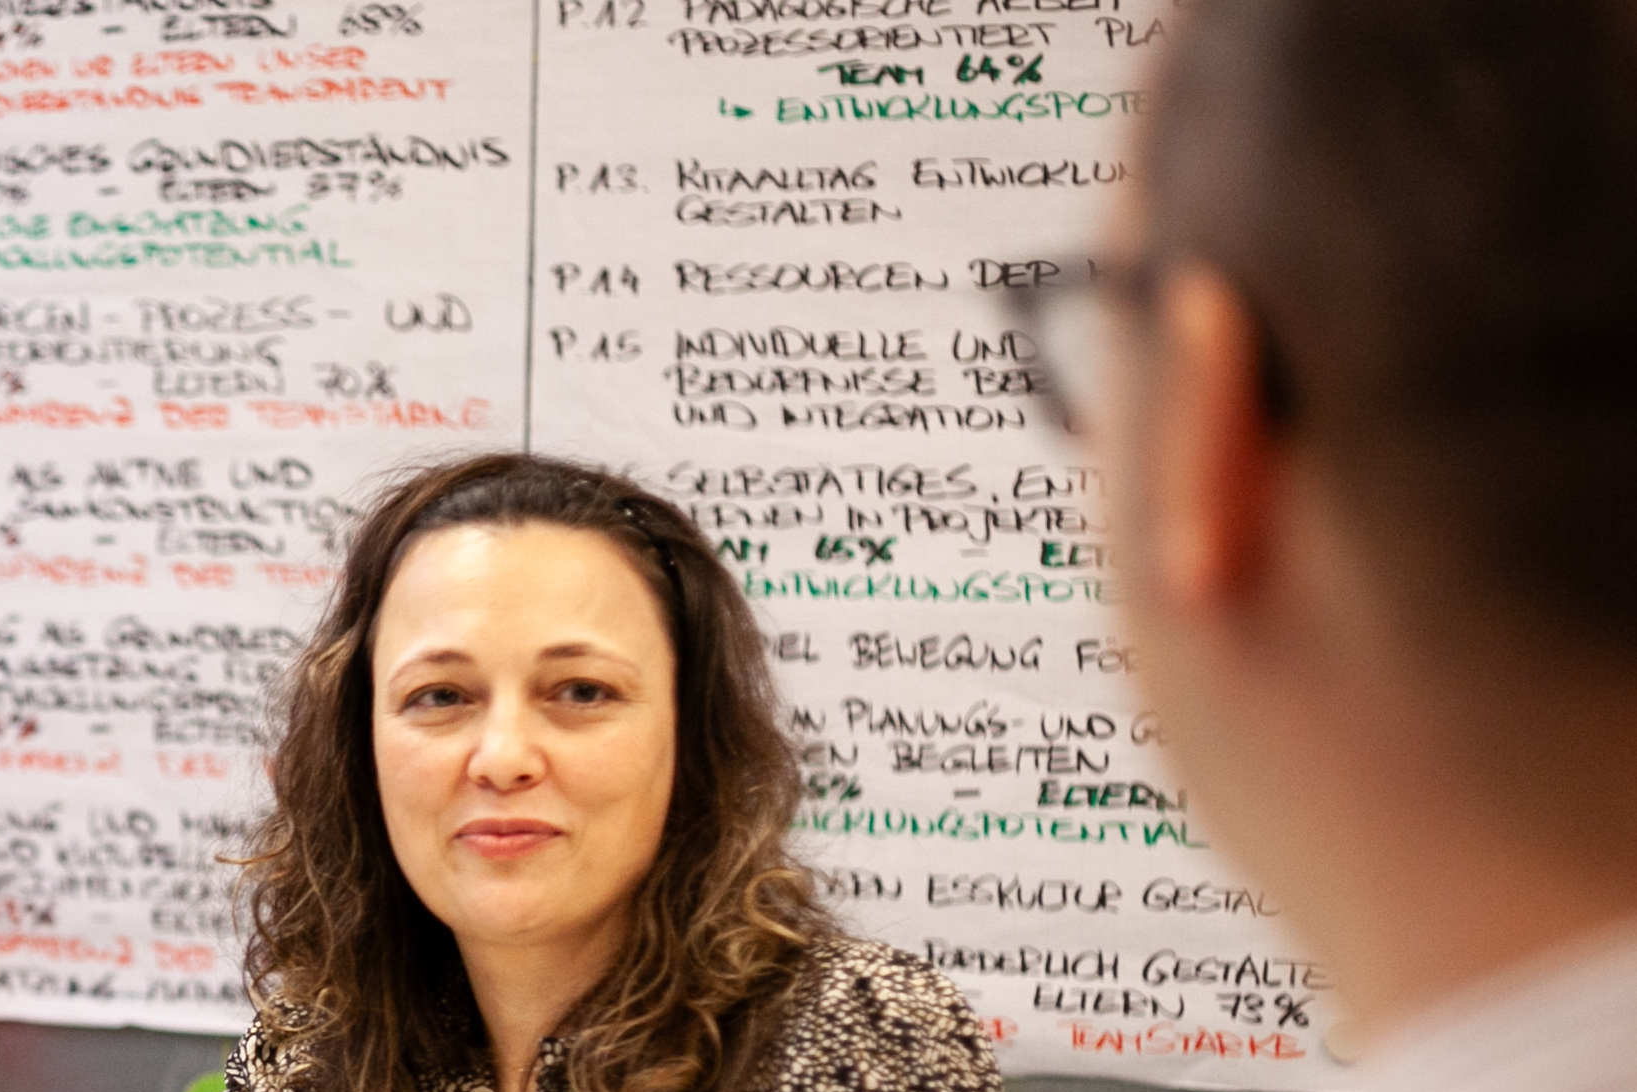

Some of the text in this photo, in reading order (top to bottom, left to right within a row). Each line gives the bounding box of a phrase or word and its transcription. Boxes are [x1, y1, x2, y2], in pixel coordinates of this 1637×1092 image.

[159, 13, 299, 42] ELTERN
[667, 24, 1059, 57] PROZESSORIENTIERT
[816, 53, 1044, 88] TEAM 64%
[676, 194, 904, 228] GESTALTEN
[674, 258, 951, 297] RESSOURCEN
[384, 290, 475, 333] UND
[675, 325, 928, 363] INDIVIDUELLE
[952, 329, 1040, 365] UND
[673, 401, 759, 431] UND
[229, 457, 315, 490] UND
[848, 632, 1044, 673] BEWEGUNG
[1040, 709, 1117, 742] UND
[892, 740, 1111, 776] BEGLEITEN
